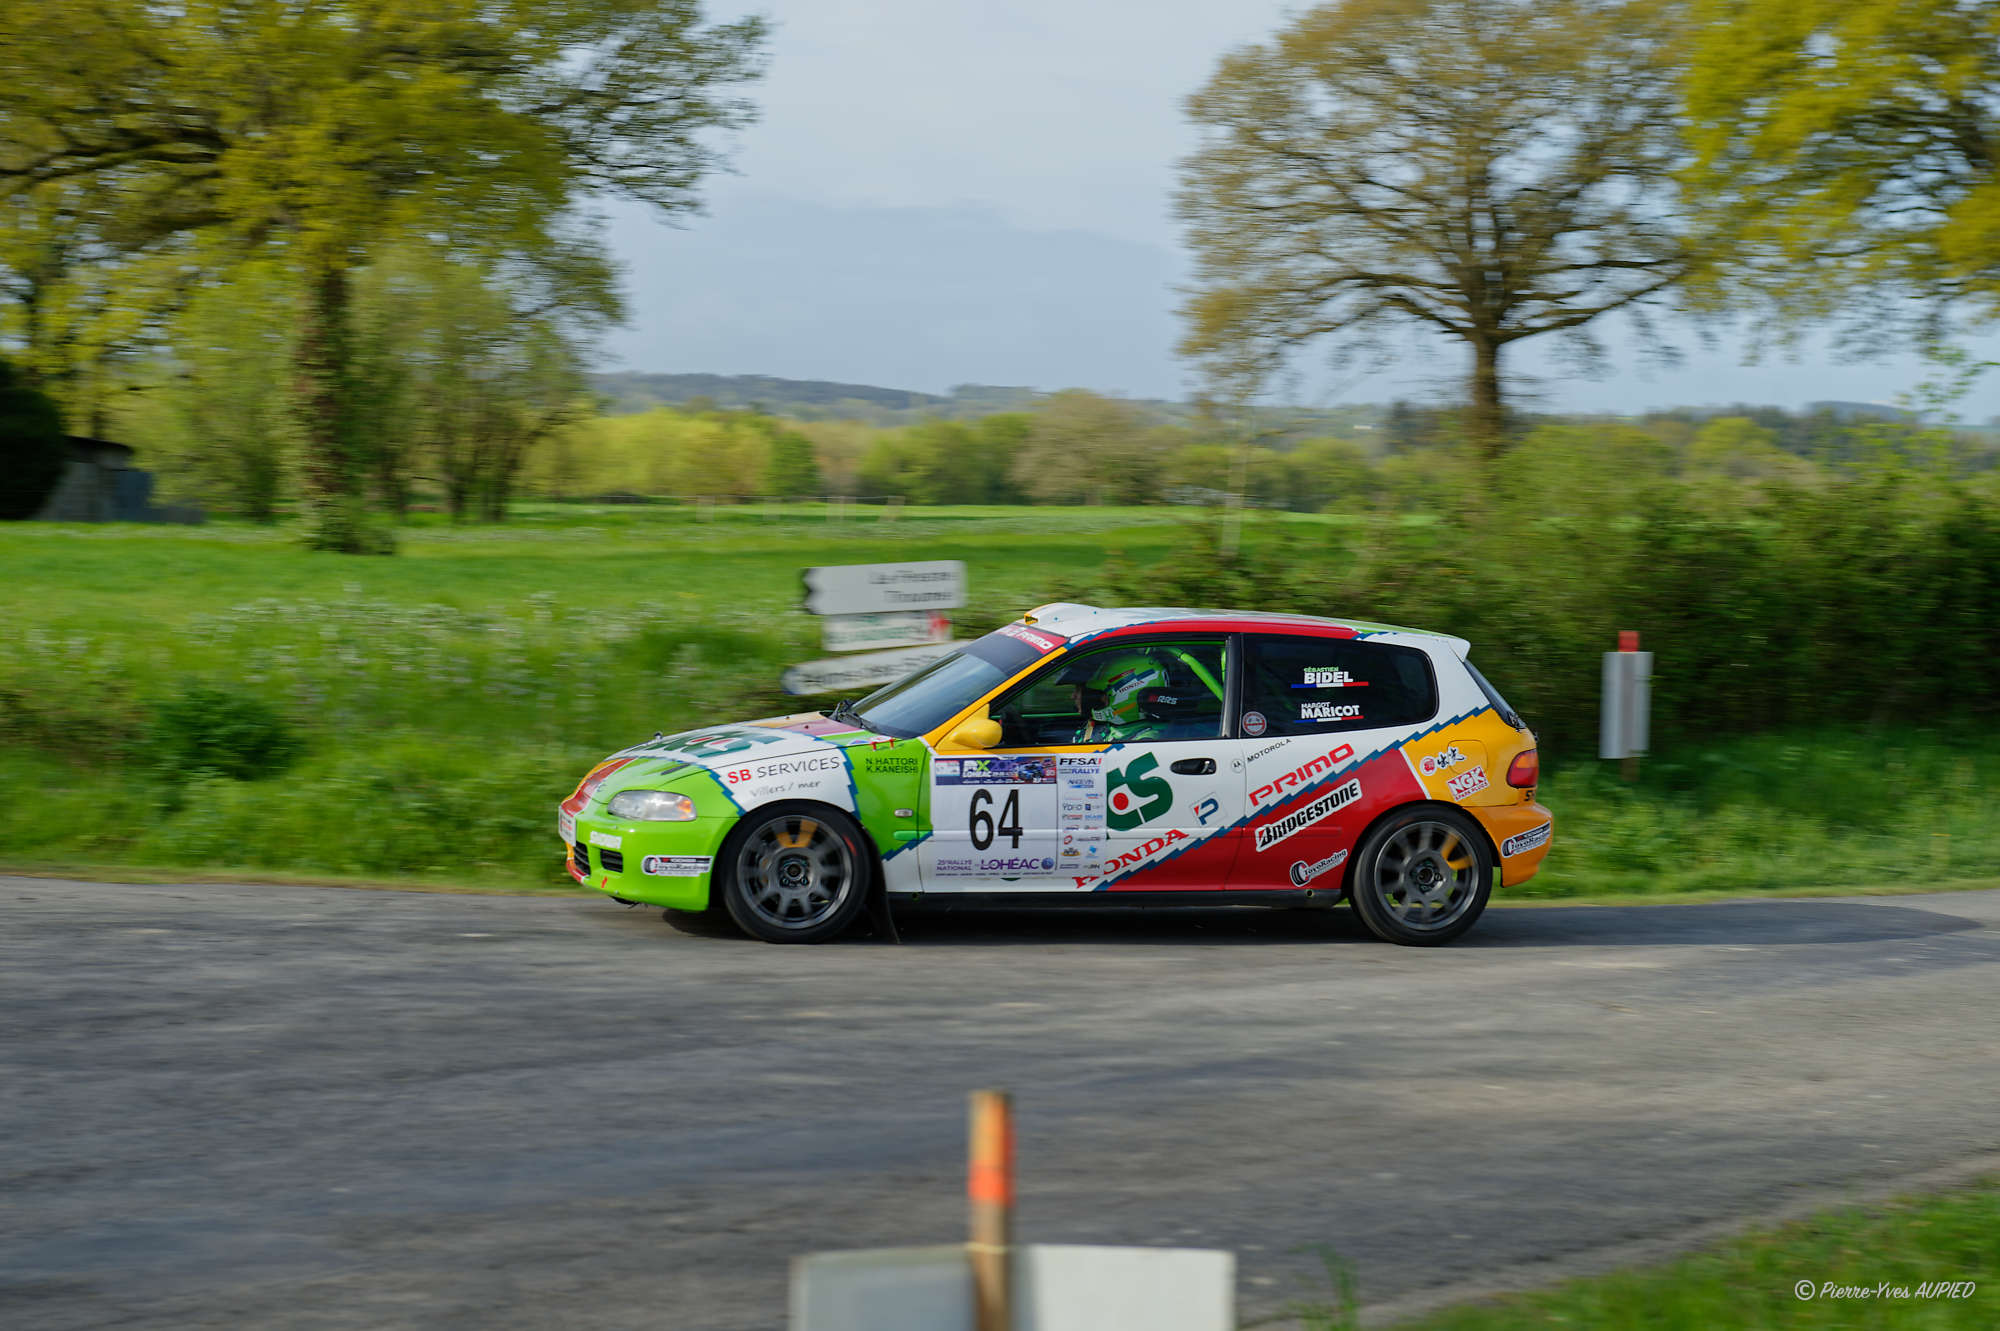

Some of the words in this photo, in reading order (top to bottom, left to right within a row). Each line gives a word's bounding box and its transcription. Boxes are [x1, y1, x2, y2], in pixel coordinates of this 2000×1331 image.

[1303, 671, 1354, 685] BIDEL
[1301, 701, 1331, 709] MARGOT
[1301, 704, 1360, 719] MARICOT
[1246, 738, 1292, 763] MOTOROLA
[727, 769, 752, 784] SB
[757, 756, 840, 779] SERVICES
[1059, 757, 1097, 766] FFSA
[798, 781, 822, 789] mer
[1248, 743, 1355, 807] PRIMO
[1449, 767, 1485, 796] NGK
[969, 788, 1023, 851] 64
[1259, 782, 1359, 848] BRIDGESTONE
[980, 857, 1040, 870] LOHÉAC
